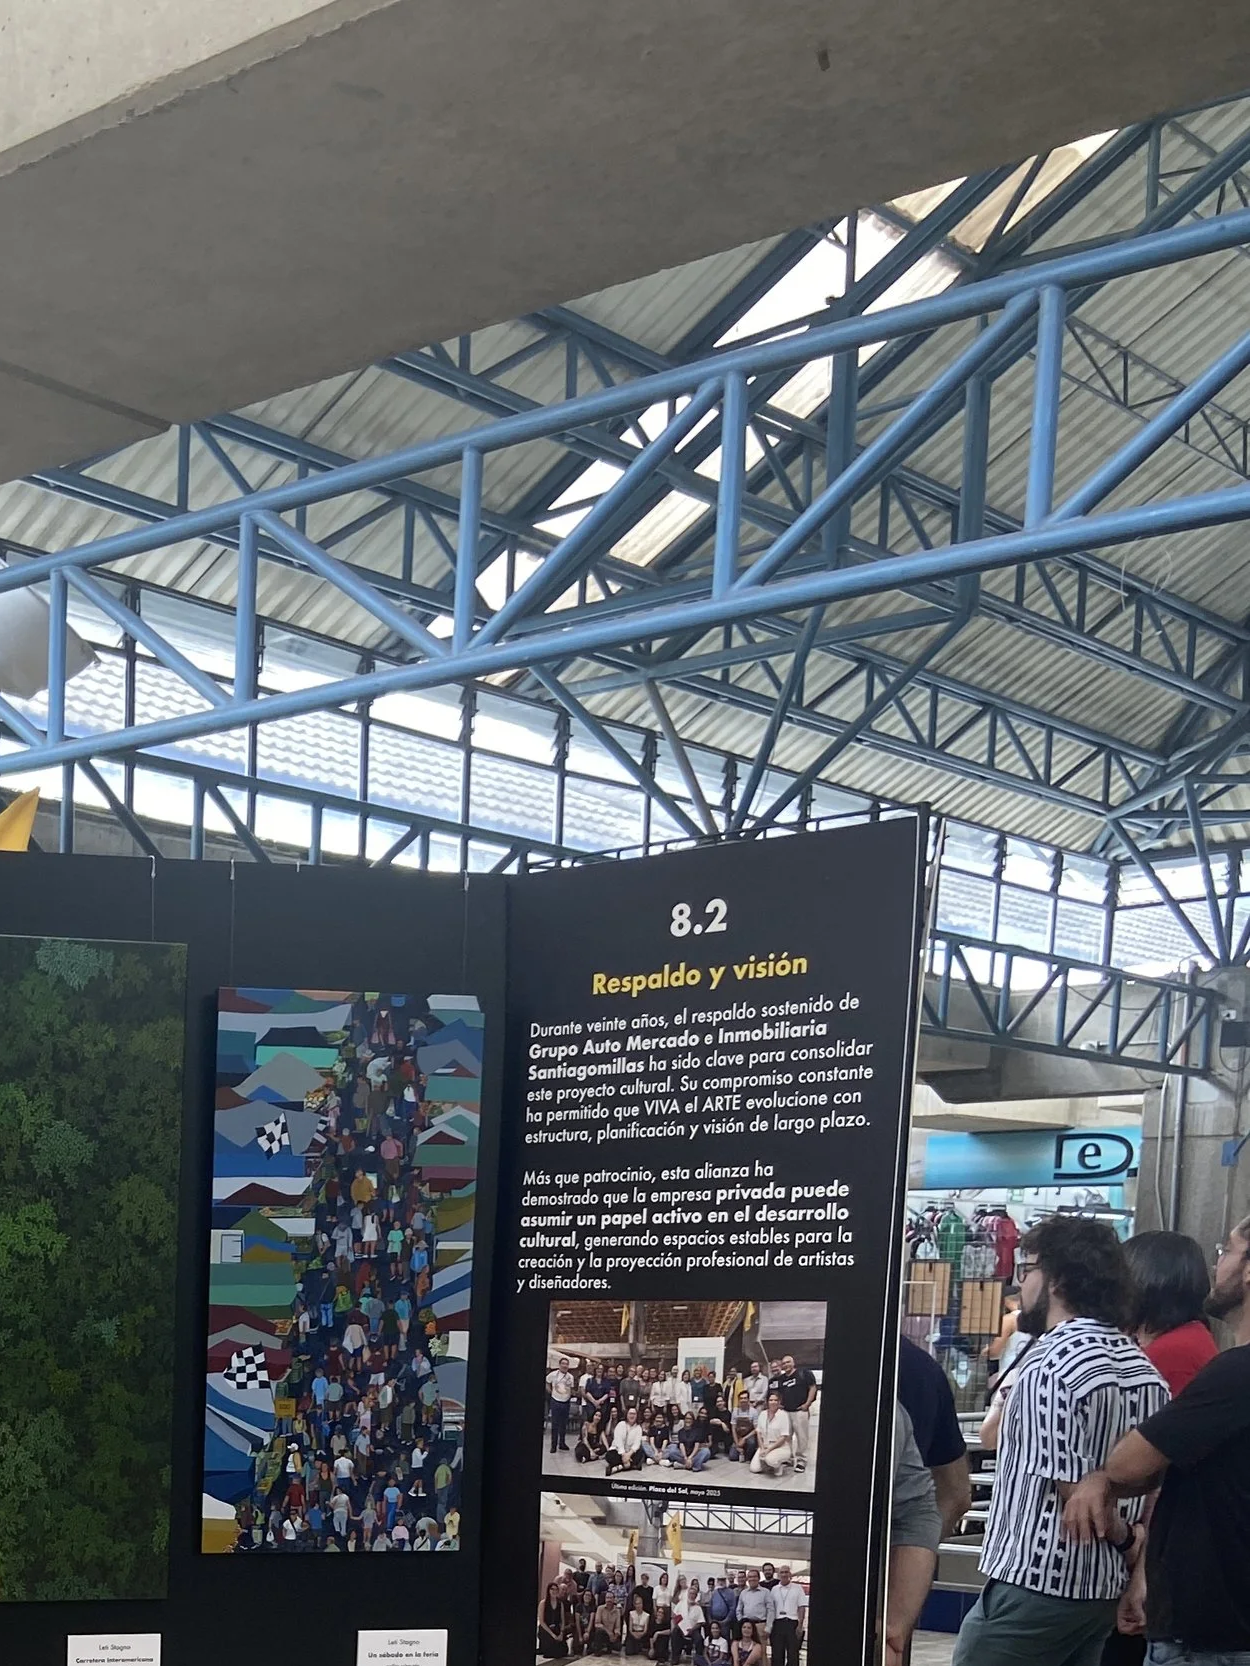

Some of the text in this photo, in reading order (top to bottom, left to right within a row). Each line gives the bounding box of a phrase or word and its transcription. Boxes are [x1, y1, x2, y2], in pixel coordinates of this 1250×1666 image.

[670, 898, 727, 937] 8.2
[593, 952, 807, 997] Respaldo y visión
[530, 992, 859, 1038] Durante veinte años, el respaldo sostenido de
[529, 1019, 827, 1061] Grupo Auto Mercado e Inmobiliaria
[528, 1038, 874, 1081] Santiagomillas ha sido clave para consolidar
[527, 1065, 873, 1104] este proyecto cultural. Su compromiso constante
[526, 1091, 861, 1126] ha permitido que VIVA el ARTE evolucione con
[525, 1110, 870, 1144] estructura, planificación y visión de largo plazo.
[523, 1160, 773, 1188] Más que patrocinio, esta alianza ha
[522, 1179, 849, 1208] demostrado que la empresa privada puede
[521, 1202, 849, 1230] asumir un papel activo en el desarrollo
[519, 1225, 852, 1251] cultural, generando espacios estables para la
[518, 1249, 854, 1272] creación y la proyección profesional de artistas
[517, 1273, 611, 1293] y diseñadores.
[649, 1485, 666, 1493] Plaza
[666, 1486, 677, 1494] del
